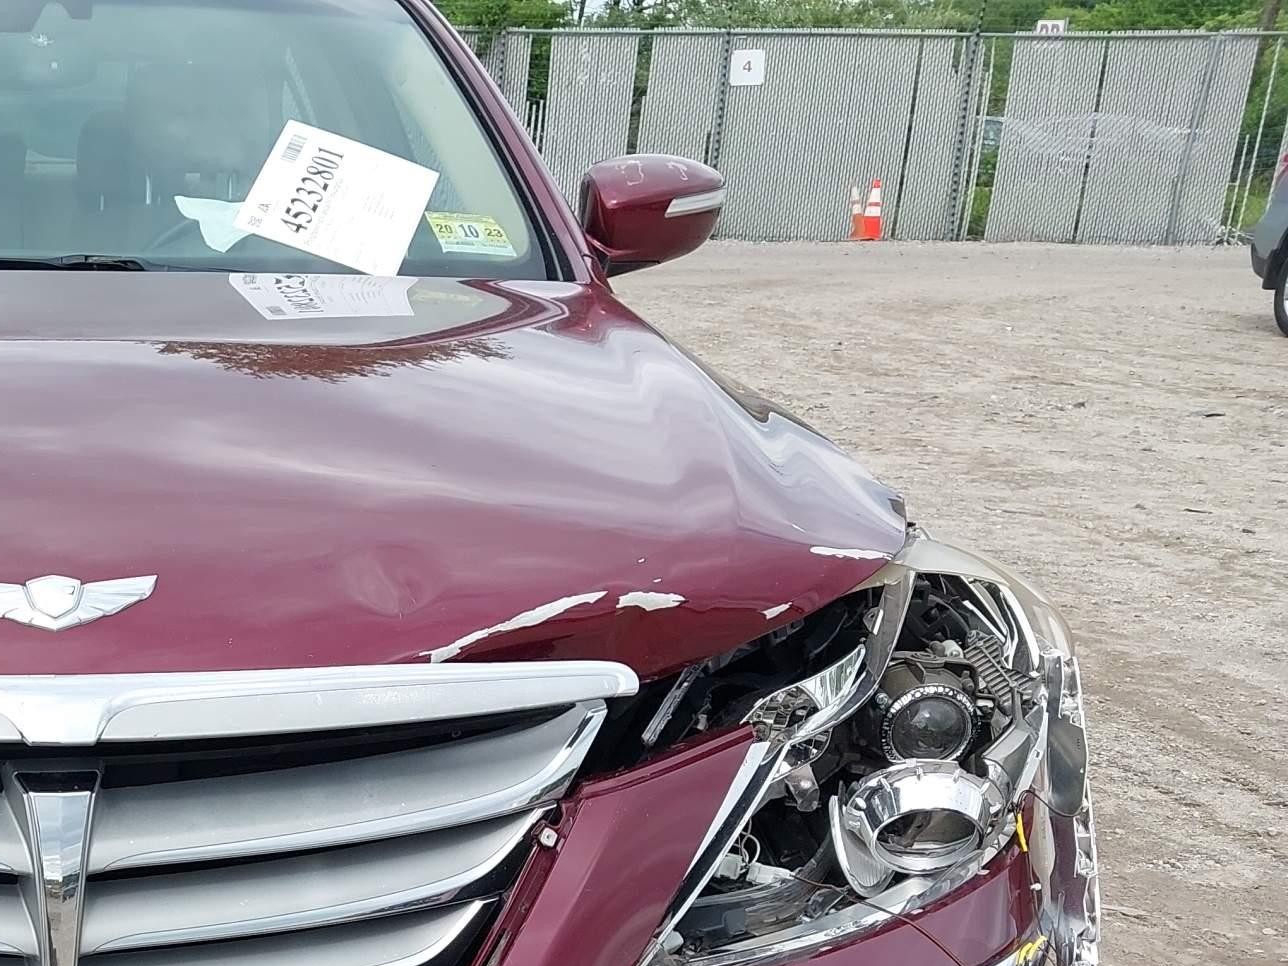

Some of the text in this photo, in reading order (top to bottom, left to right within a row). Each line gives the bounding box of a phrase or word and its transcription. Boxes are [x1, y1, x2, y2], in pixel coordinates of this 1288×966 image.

[742, 60, 753, 72] 4
[280, 147, 344, 234] 45232801
[435, 223, 504, 238] 20 10 23
